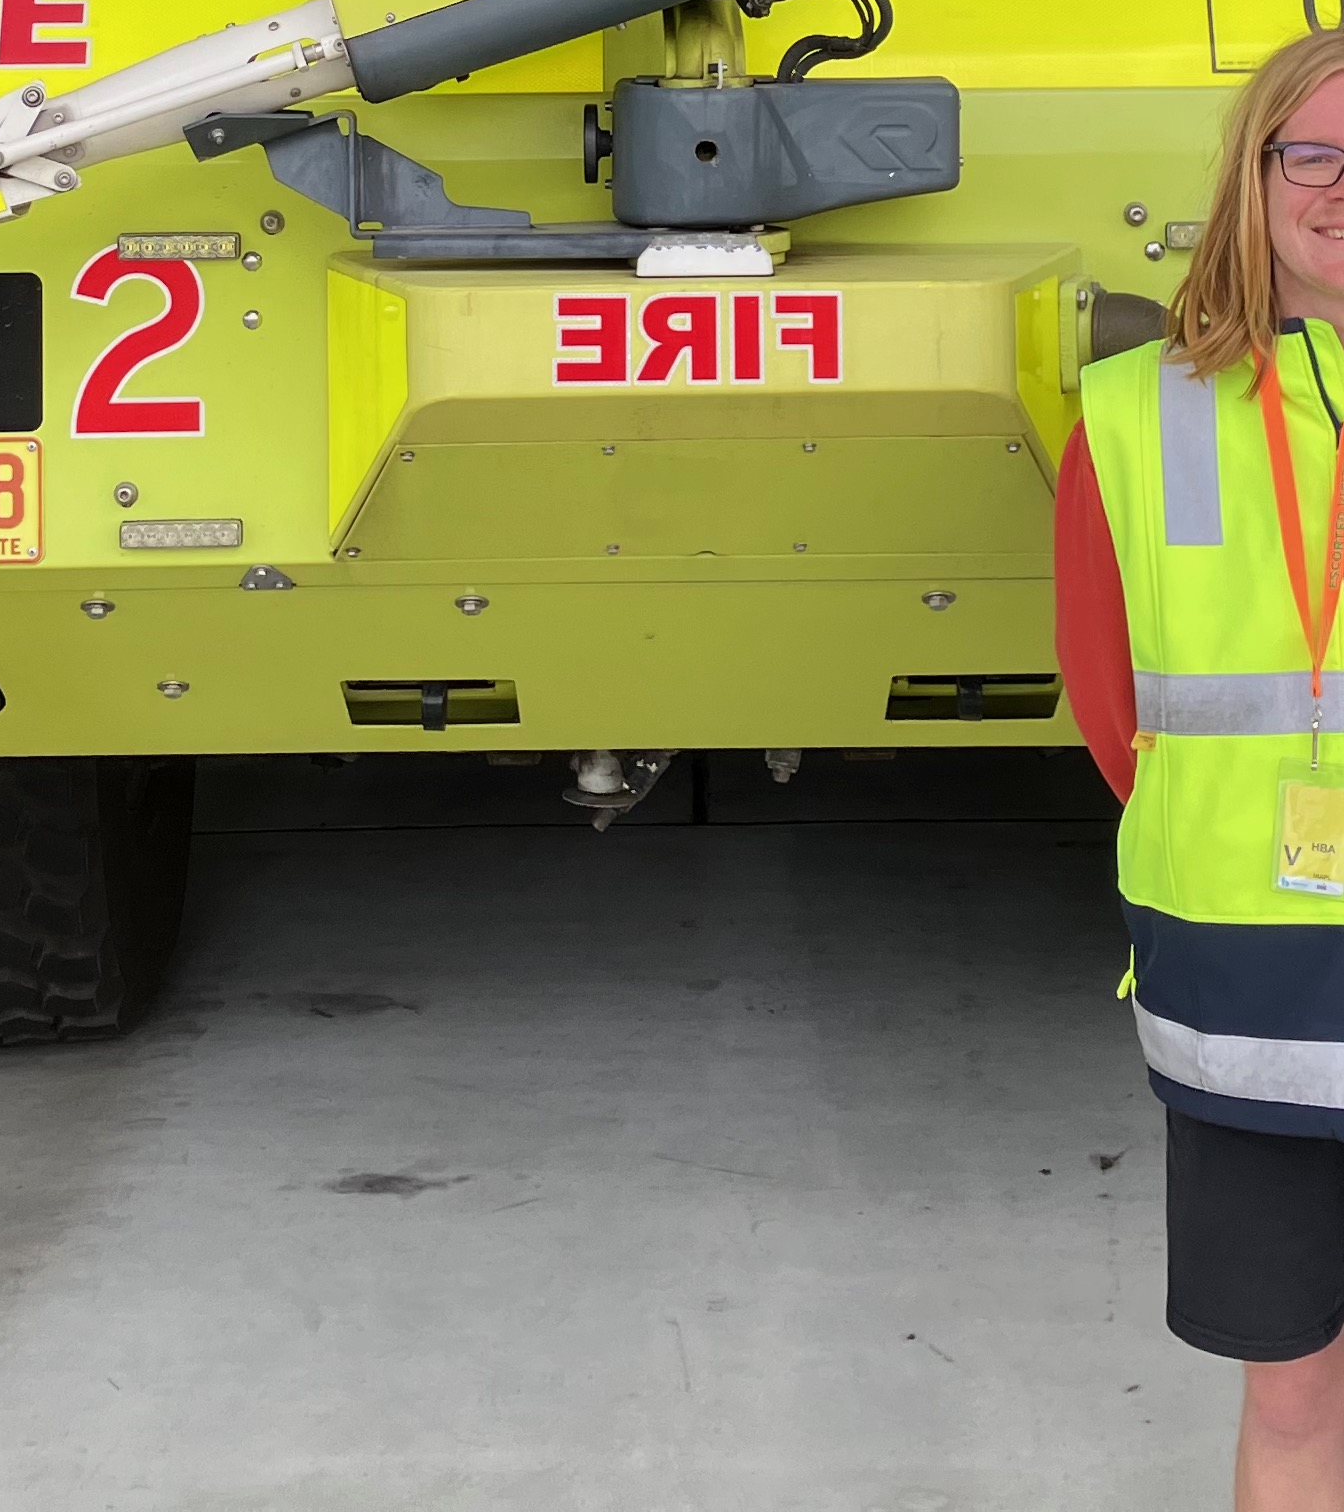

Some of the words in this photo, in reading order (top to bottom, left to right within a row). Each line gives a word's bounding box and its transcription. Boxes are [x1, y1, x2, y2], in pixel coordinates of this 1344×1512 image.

[70, 245, 205, 439] 2
[1284, 844, 1302, 866] V
[1311, 842, 1335, 854] HBA
